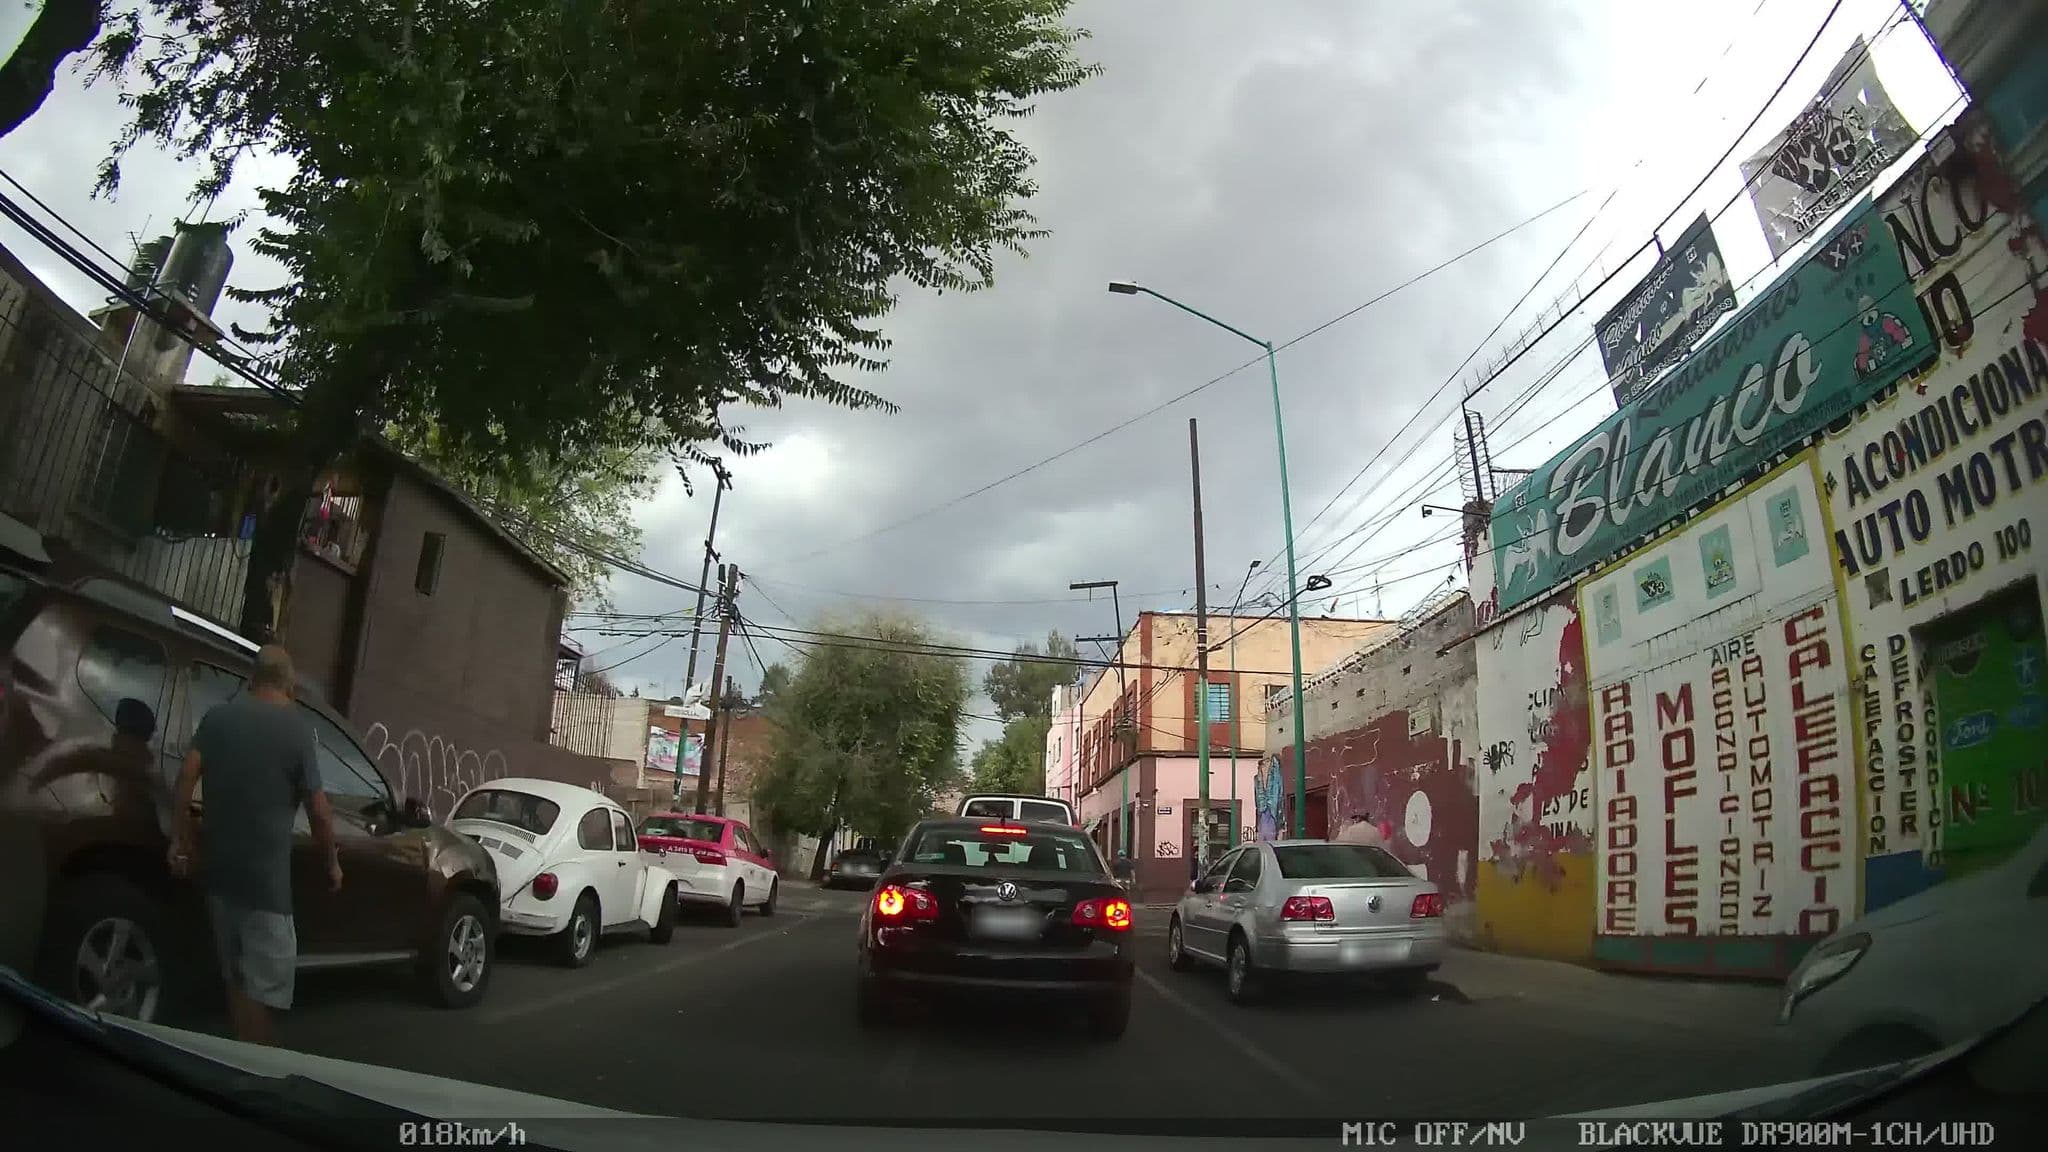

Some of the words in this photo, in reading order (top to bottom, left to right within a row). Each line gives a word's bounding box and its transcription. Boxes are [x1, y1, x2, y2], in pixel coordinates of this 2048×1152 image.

[1548, 332, 1823, 556] Blanco
[1834, 488, 1931, 577] AUTO
[1900, 541, 1984, 607] LERDO
[1994, 517, 2031, 560] 100
[1710, 634, 1755, 668] AIRE
[1569, 788, 1589, 813] DE
[1742, 655, 1774, 917] AUTOMOTRIZ
[1860, 644, 1886, 854] CALEFACCION
[1887, 633, 1918, 835] DEFROSTER
[1951, 719, 1990, 746] Ford
[1655, 682, 1699, 935] MOFLES
